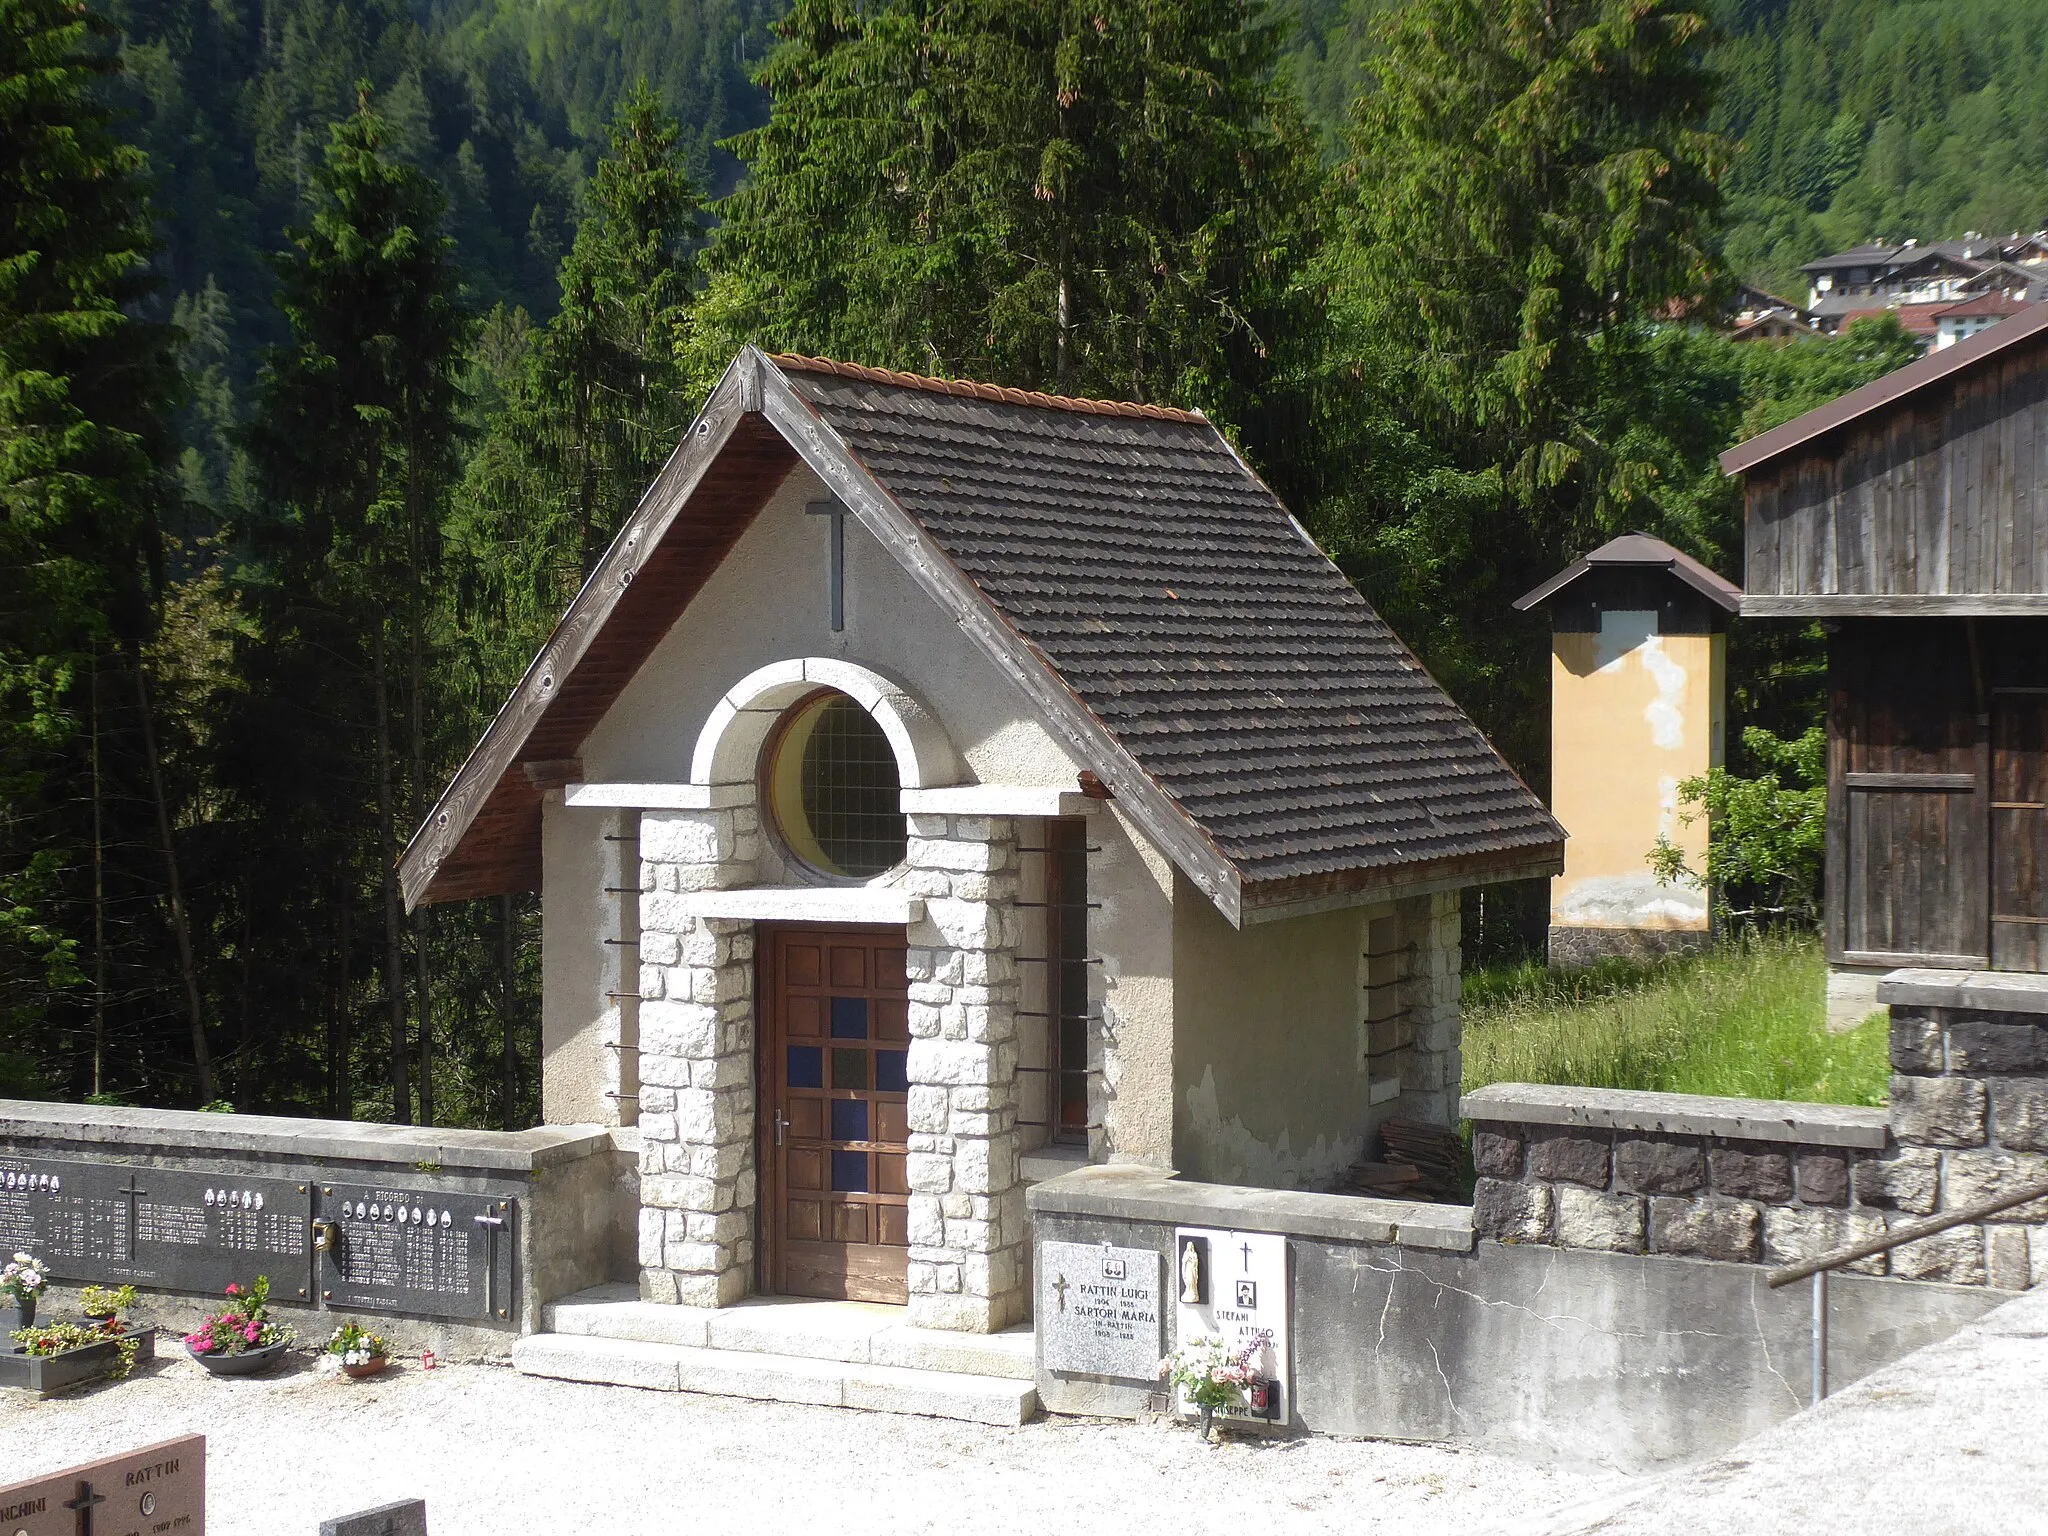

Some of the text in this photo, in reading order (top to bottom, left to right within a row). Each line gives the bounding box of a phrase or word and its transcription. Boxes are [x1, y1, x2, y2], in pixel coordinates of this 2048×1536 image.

[375, 1191, 410, 1203] RICORDO
[1080, 1284, 1148, 1300] RATTIN LUIGI
[1074, 1306, 1156, 1323] SARTORI MARIA
[1216, 1310, 1249, 1322] STEFANI
[1107, 1321, 1133, 1330] RATTIN
[126, 1458, 180, 1488] RATTIN
